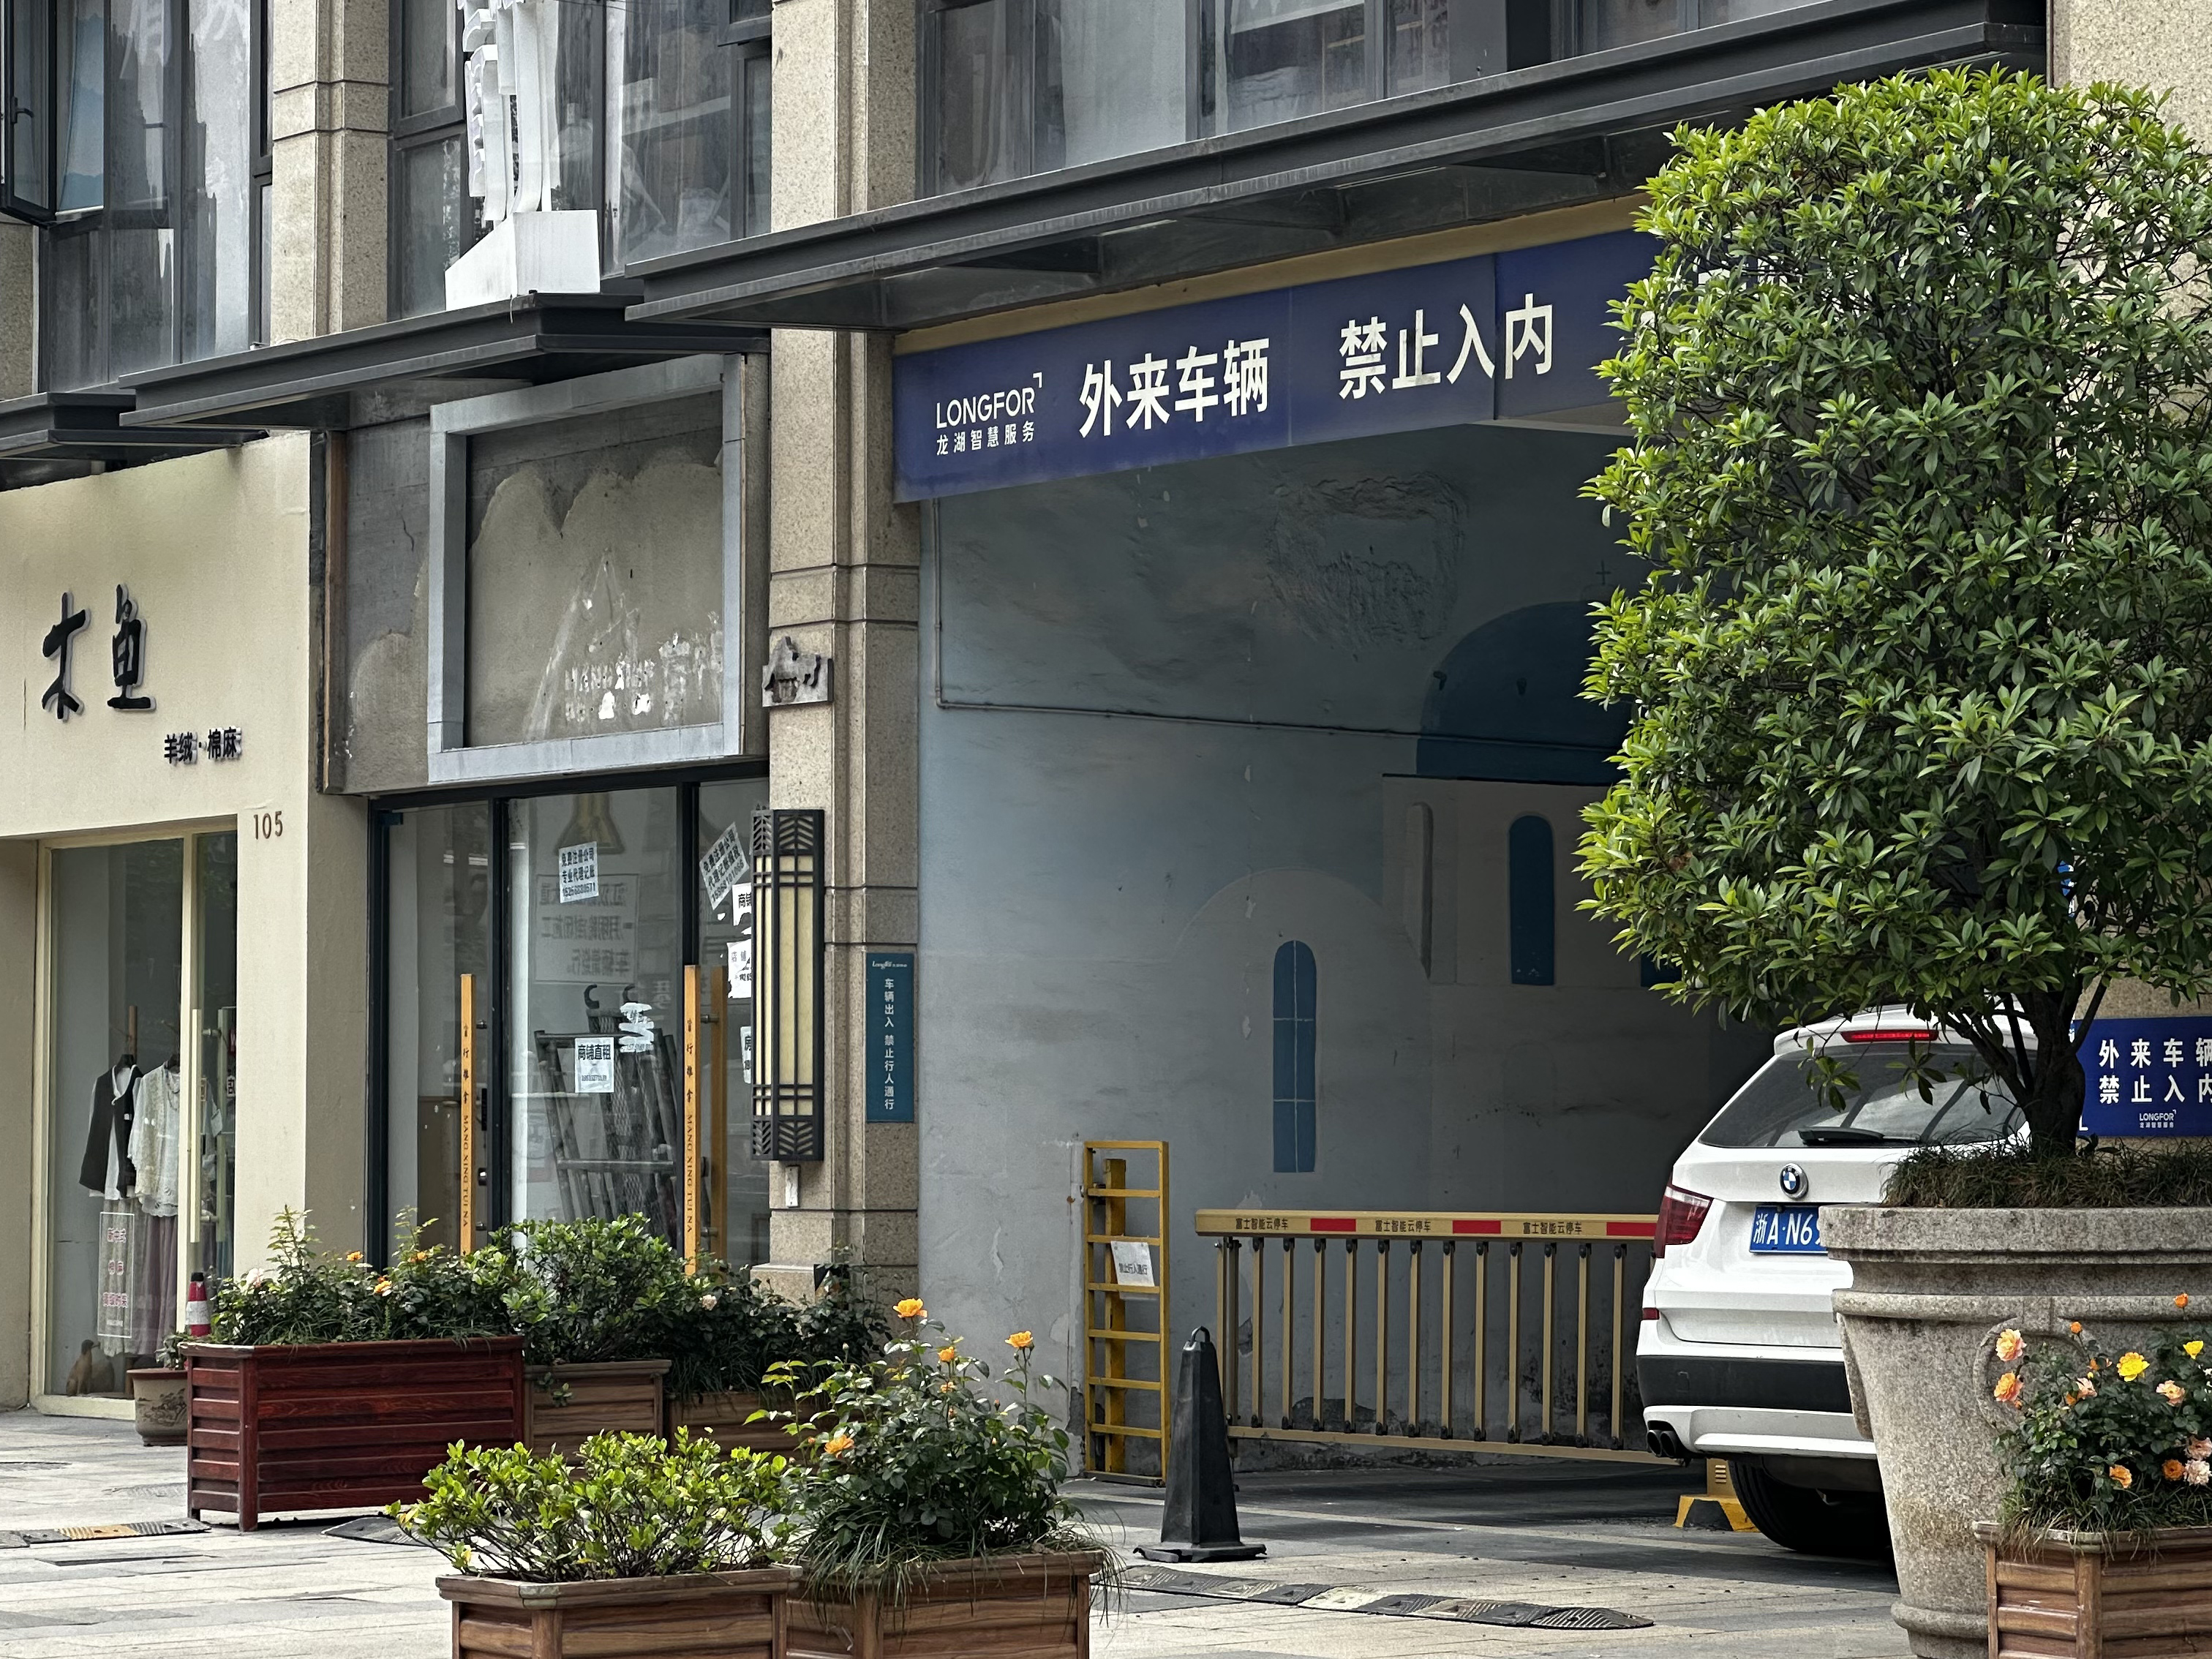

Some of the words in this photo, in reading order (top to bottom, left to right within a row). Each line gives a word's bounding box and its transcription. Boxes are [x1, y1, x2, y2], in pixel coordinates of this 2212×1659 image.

[1079, 338, 1271, 439] 外来车辆
[1339, 293, 1554, 399] 禁止入内
[936, 386, 1035, 429] LONGFOR
[936, 421, 1035, 456] 龙湖智慧服务
[253, 810, 284, 840] 105
[884, 978, 895, 1028] 车辆出入
[578, 1045, 612, 1061] 商铺直租
[2098, 1037, 2212, 1069] 外来车辆
[884, 1035, 895, 1110] 禁止行人通行
[2098, 1072, 2212, 1105] 禁止入内
[2139, 1113, 2174, 1121] LONGFOR
[462, 1211, 470, 1227] NA
[686, 1216, 693, 1233] NA
[1235, 1217, 1289, 1230] 富士智能云停车
[1375, 1219, 1432, 1233] 富士智能云停车
[1523, 1221, 1583, 1235] 富士智能云停车
